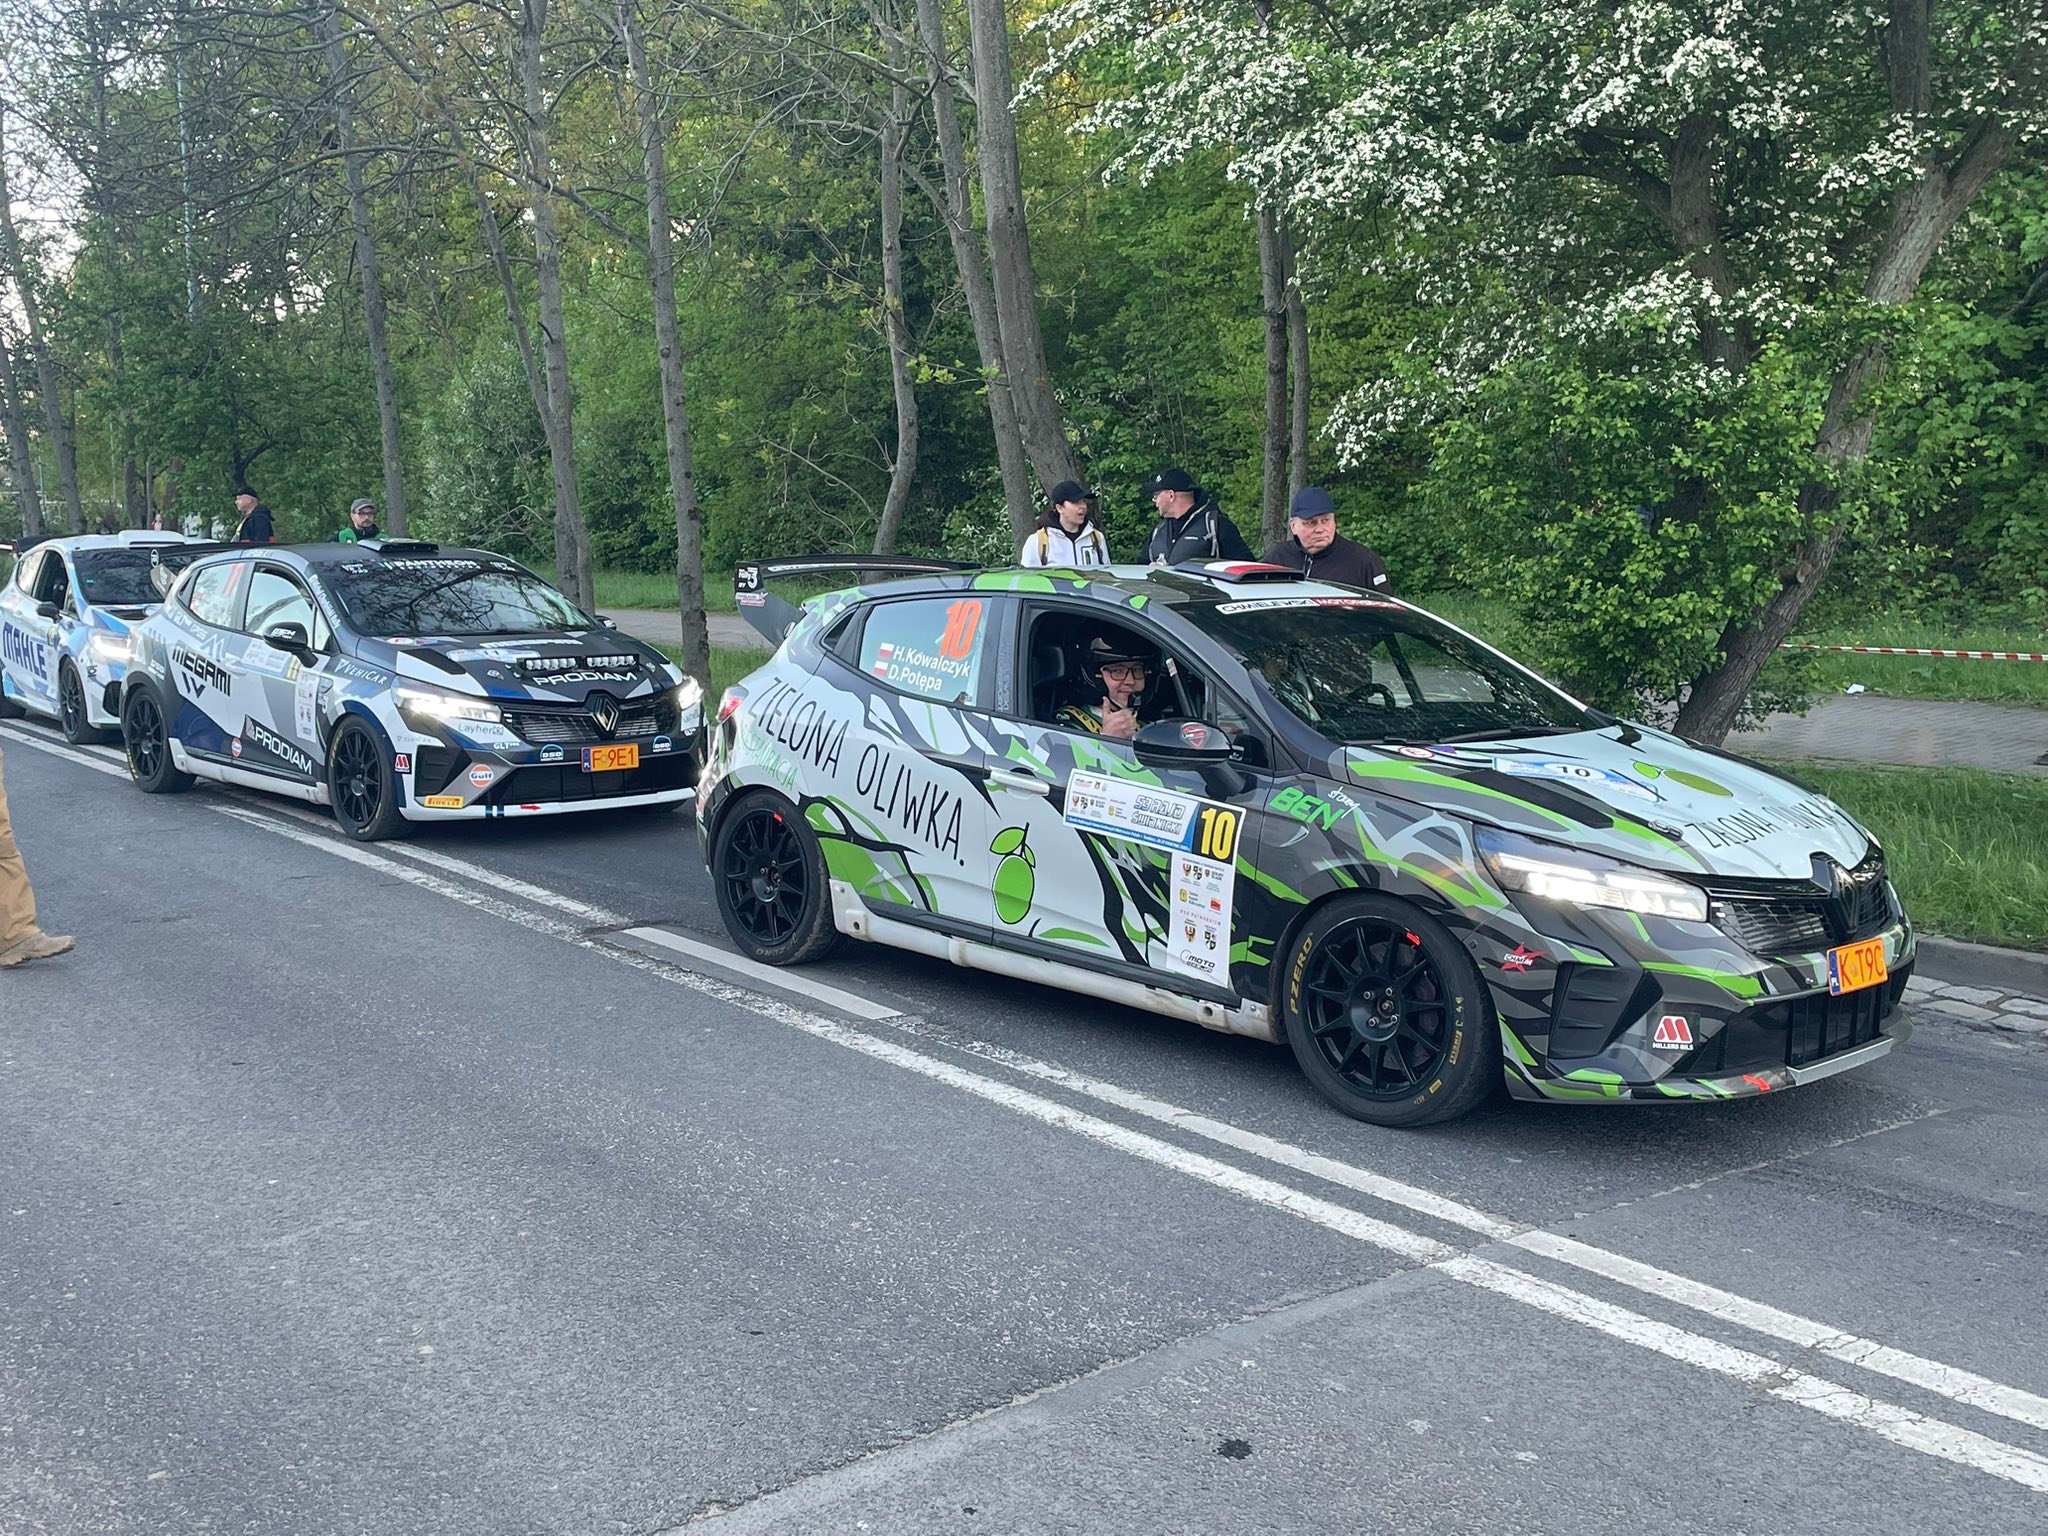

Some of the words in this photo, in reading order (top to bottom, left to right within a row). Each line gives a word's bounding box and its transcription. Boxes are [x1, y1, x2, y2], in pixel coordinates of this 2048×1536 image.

[939, 599, 983, 660] 10
[3, 621, 48, 681] MAHLE
[892, 645, 971, 678] H.Kowalczyk
[172, 646, 231, 697] MEGAMI
[532, 672, 638, 686] PRODIAM
[887, 664, 942, 692] D.Potępa
[457, 723, 492, 736] Layher
[253, 726, 312, 775] PRODIAM
[592, 750, 601, 769] F
[608, 747, 635, 768] 9E1
[470, 771, 493, 780] Gulf
[747, 676, 850, 779] ZIELONA
[856, 743, 966, 867] OLIWKA.
[1556, 765, 1591, 778] 10
[428, 797, 461, 807] PIRELLI
[1133, 794, 1152, 812] 53
[1149, 798, 1187, 821] RAJD
[1268, 786, 1346, 832] BEN
[1200, 807, 1236, 860] 10
[1188, 954, 1216, 969] MOTO
[1838, 952, 1853, 988] K
[1855, 944, 1885, 983] T9C
[1652, 1042, 1680, 1050] MILLERS
